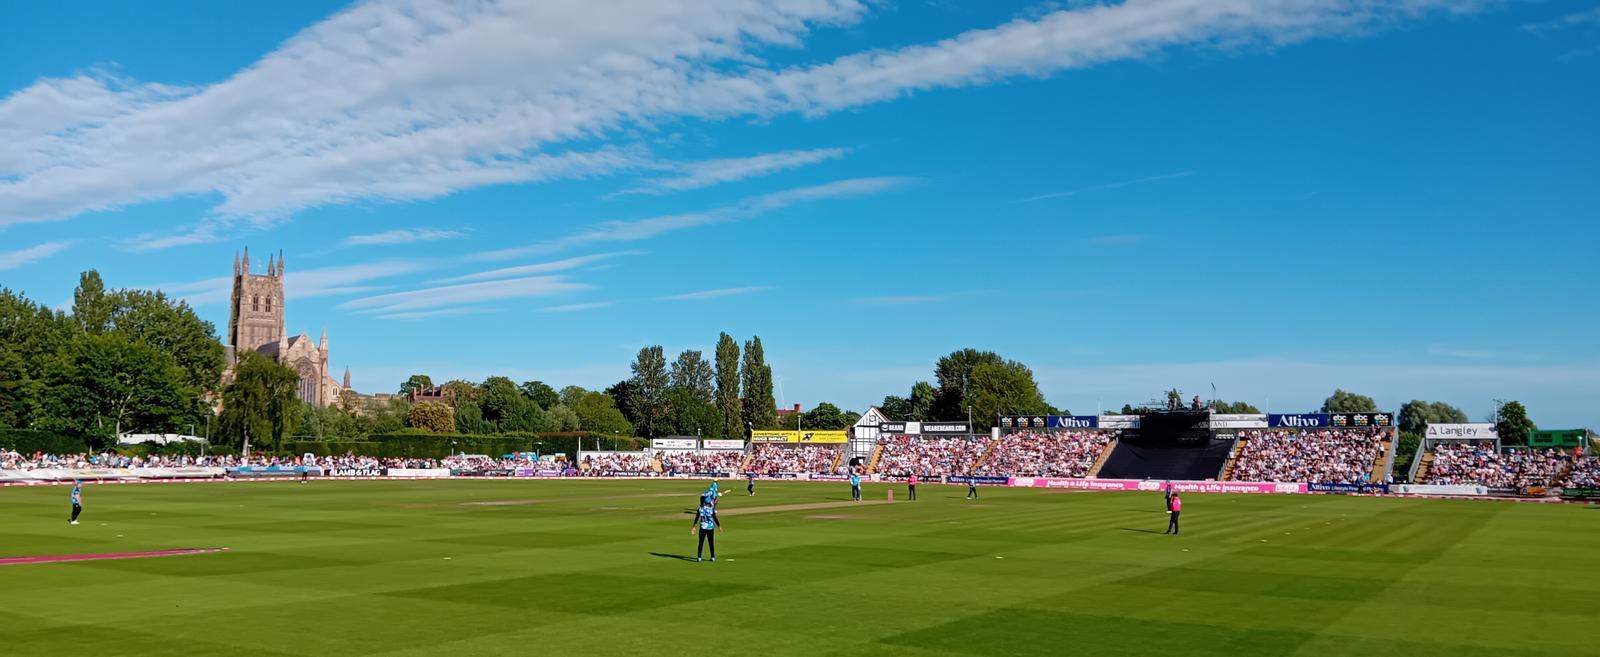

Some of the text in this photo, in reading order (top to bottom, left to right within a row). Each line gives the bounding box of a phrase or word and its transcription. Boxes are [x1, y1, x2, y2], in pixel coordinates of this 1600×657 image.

[1440, 425, 1478, 437] Langley
[1047, 479, 1069, 487] Health
[1076, 480, 1089, 488] Life
